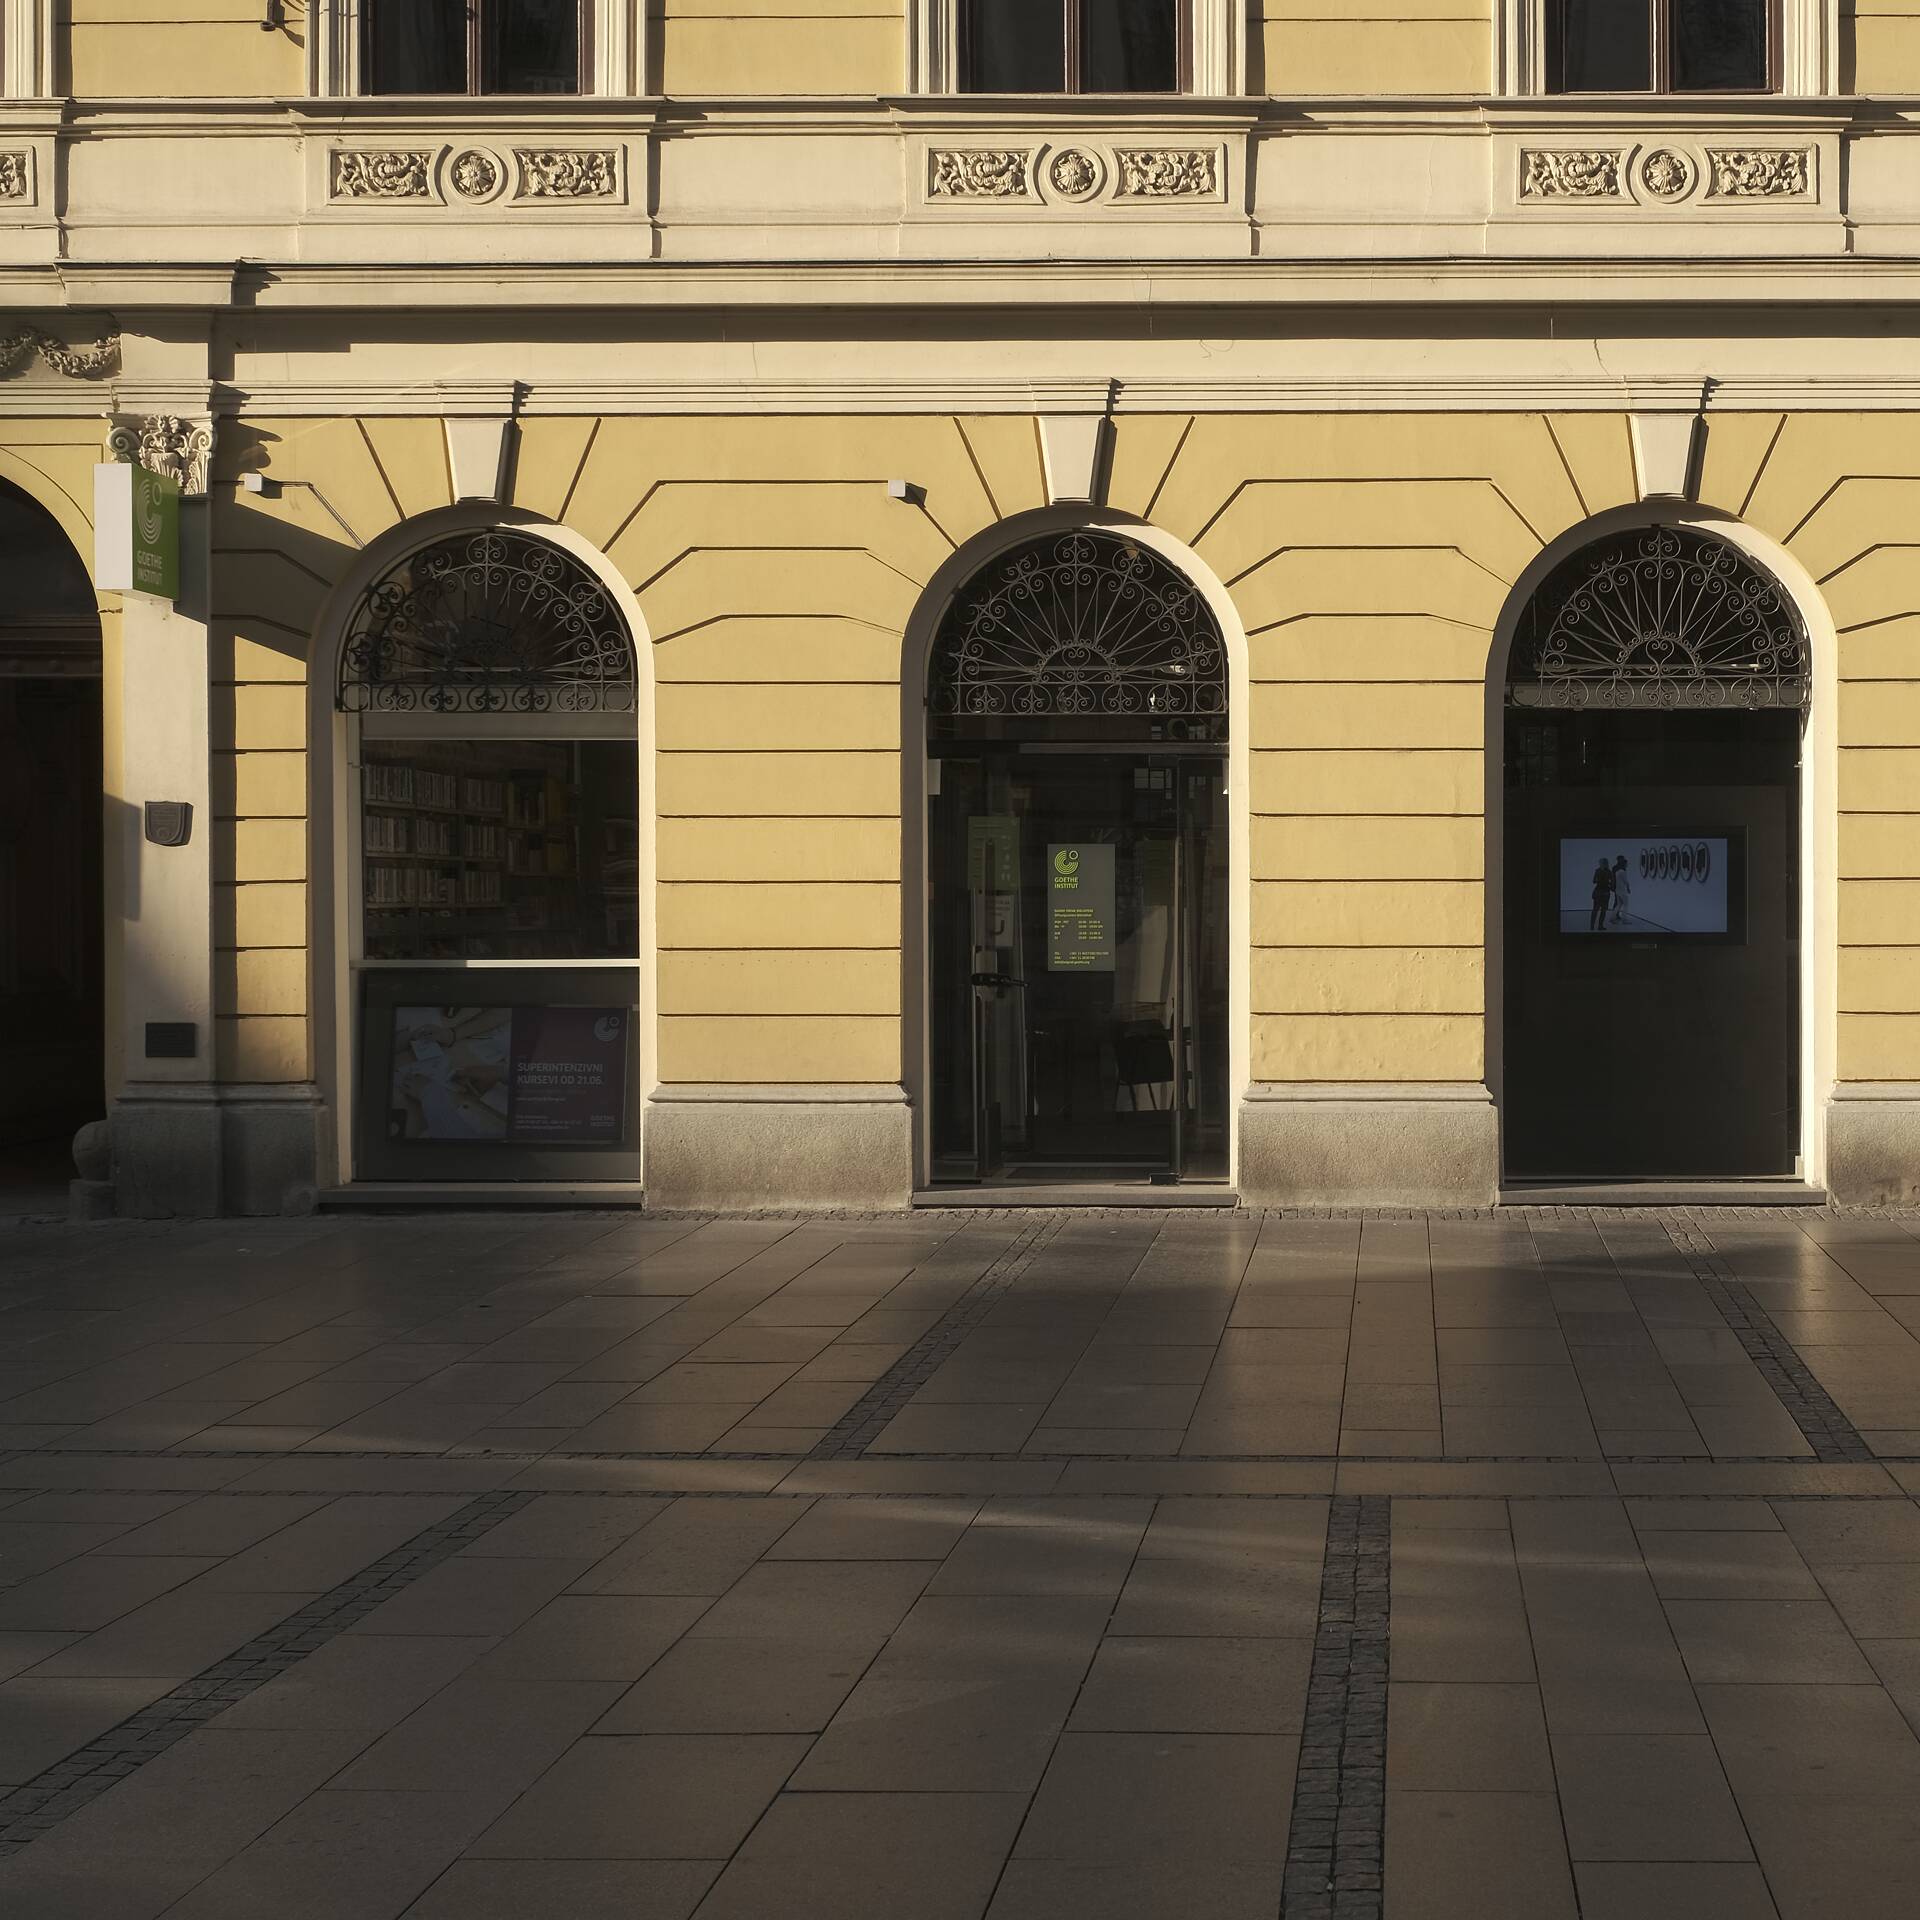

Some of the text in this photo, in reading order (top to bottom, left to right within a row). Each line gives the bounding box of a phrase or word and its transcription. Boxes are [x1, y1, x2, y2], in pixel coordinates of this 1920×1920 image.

[137, 550, 162, 570] GOETHE
[137, 567, 163, 585] INSTITUT
[517, 1062, 603, 1073] SUPERINTENZIVNI
[517, 1075, 558, 1085] KURSEVI
[560, 1075, 575, 1085] OD
